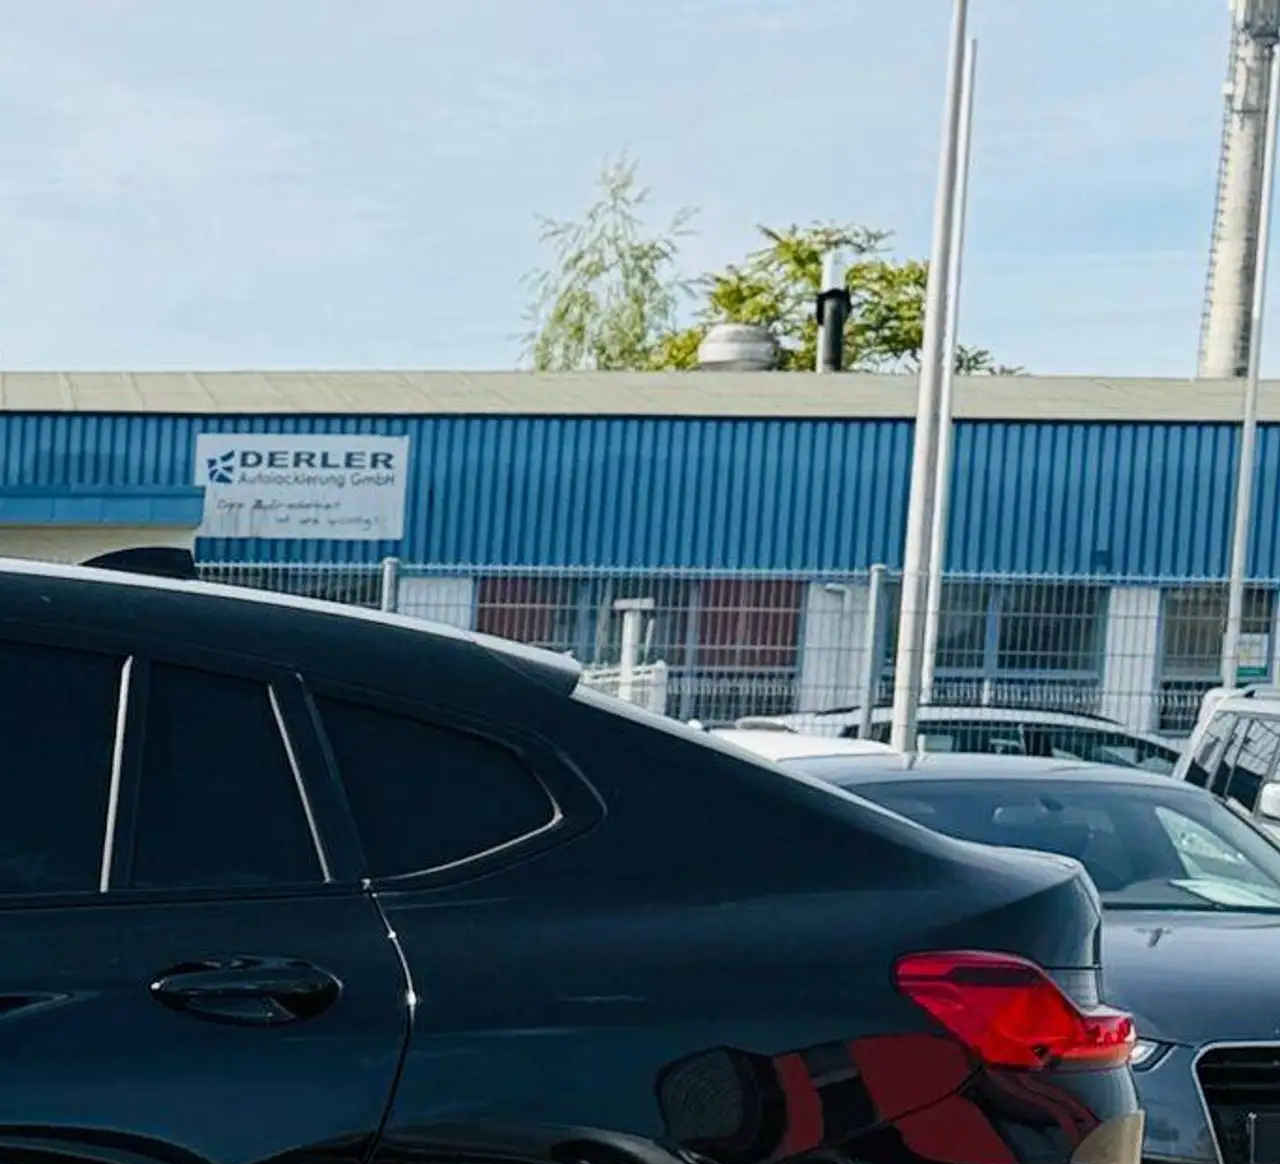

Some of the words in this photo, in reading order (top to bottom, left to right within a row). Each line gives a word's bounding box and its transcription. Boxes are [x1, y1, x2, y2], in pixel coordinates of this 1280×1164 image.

[241, 450, 395, 469] DERLER
[238, 471, 344, 488] Autolackierung
[349, 472, 396, 486] GmbH
